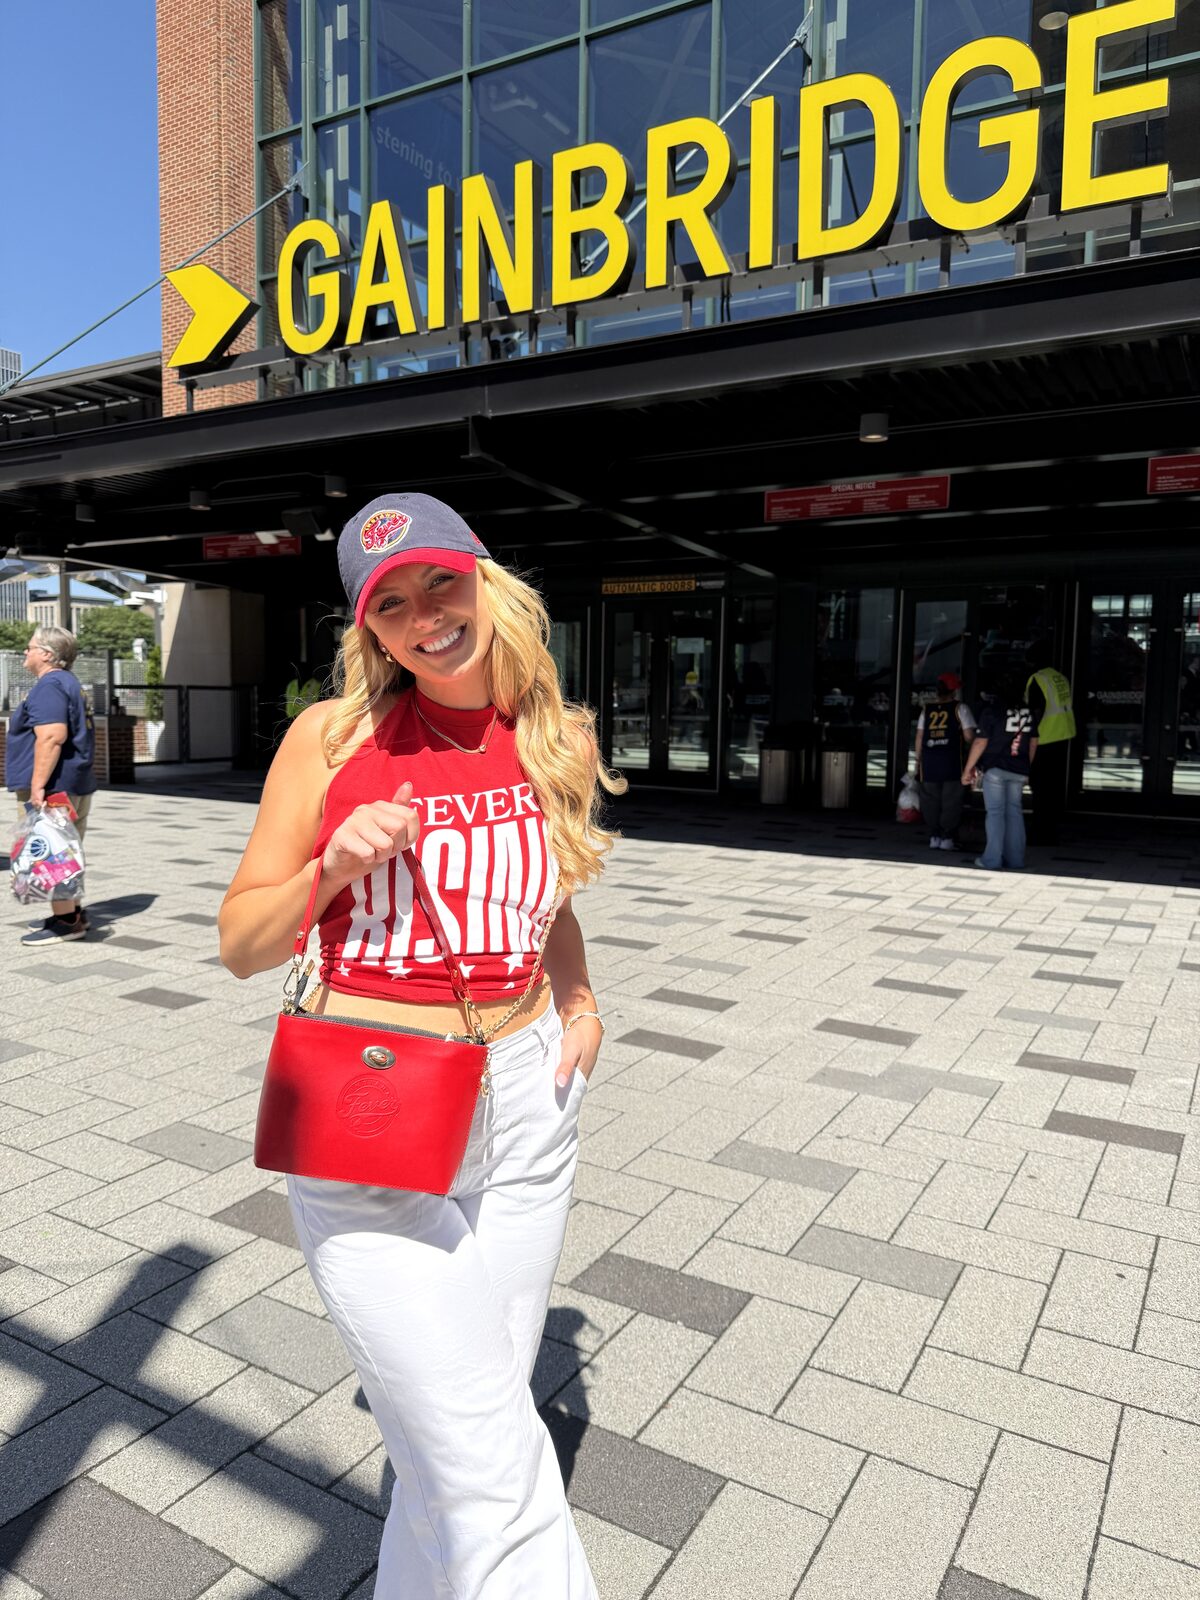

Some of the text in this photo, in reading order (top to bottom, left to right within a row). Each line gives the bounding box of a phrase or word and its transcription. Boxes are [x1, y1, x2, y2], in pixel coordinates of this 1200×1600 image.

[277, 0, 1176, 356] GAINBRIDGE
[831, 481, 877, 493] SPECIAL NOTICE
[603, 582, 658, 593] AUTOMATIC
[659, 580, 694, 592] DOORS
[1096, 691, 1143, 700] GAINBRIDG
[929, 711, 948, 730] 22
[1005, 708, 1032, 732] 22
